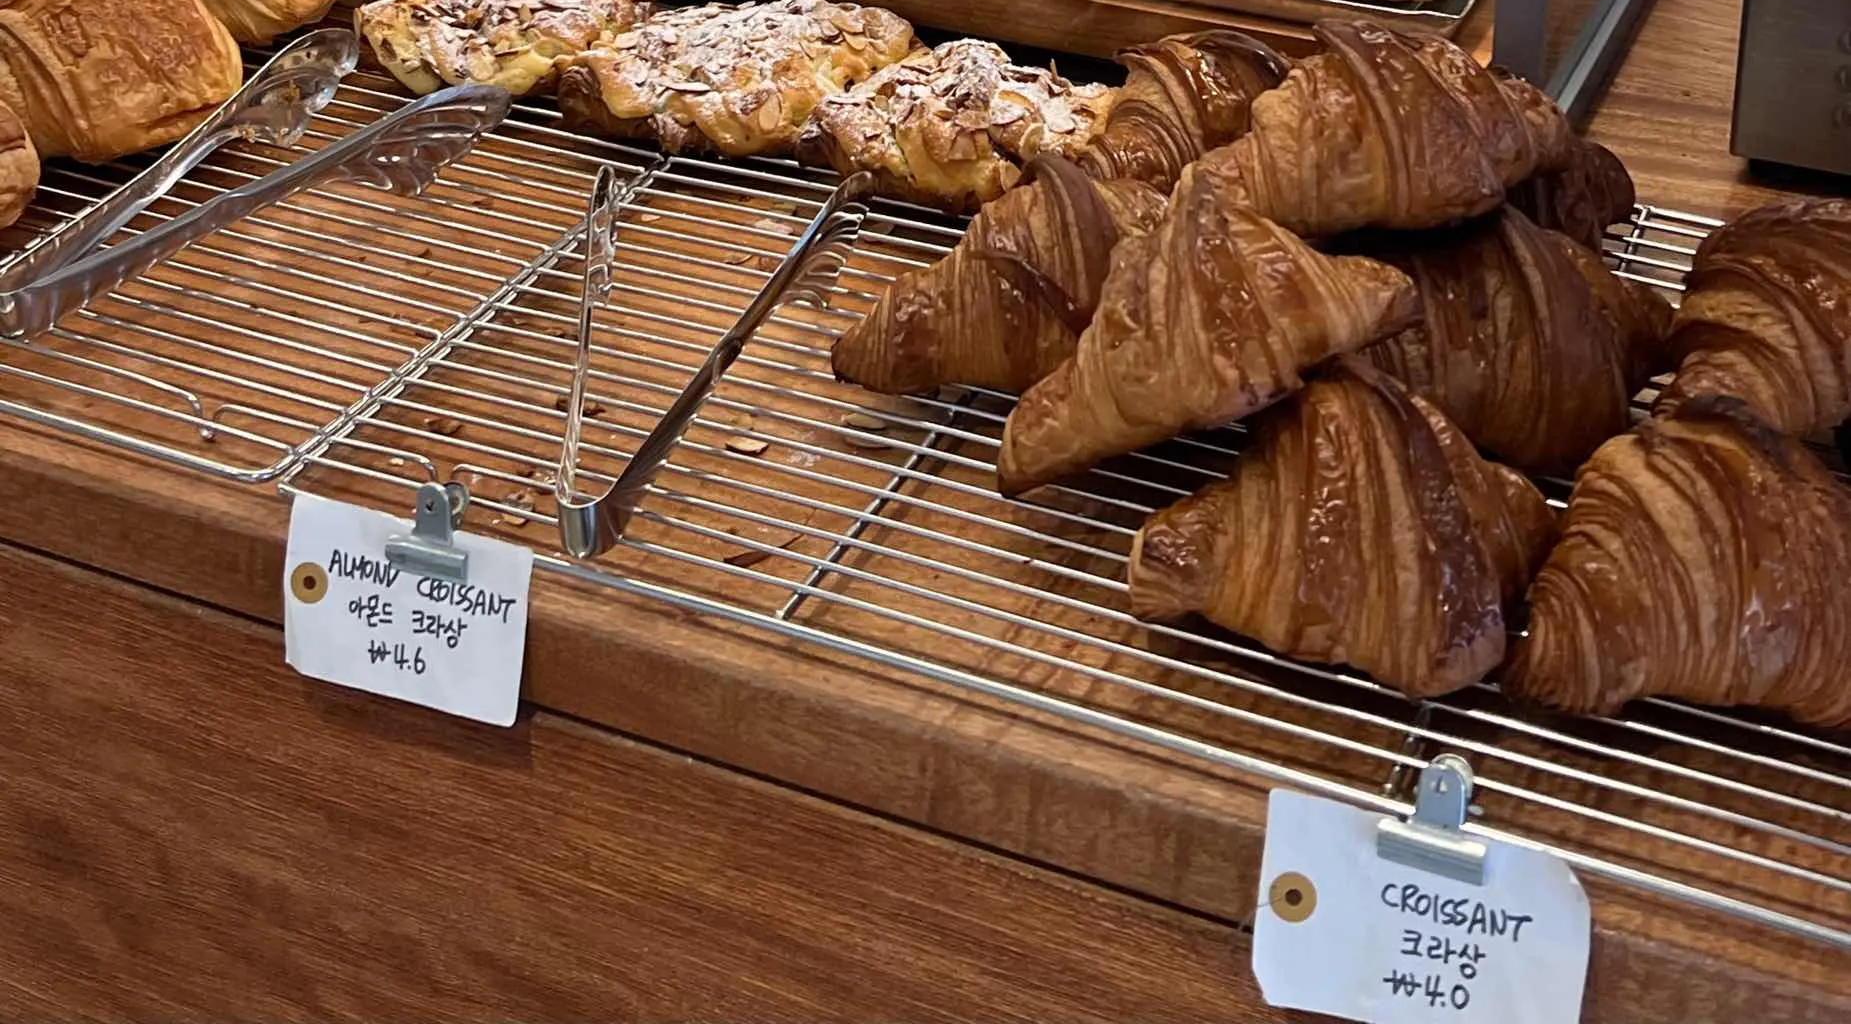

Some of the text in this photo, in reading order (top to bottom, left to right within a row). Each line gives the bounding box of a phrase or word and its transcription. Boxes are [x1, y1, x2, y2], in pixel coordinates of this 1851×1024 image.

[348, 594, 467, 649] 아몬드 크라상
[416, 576, 517, 624] CROISSANT
[1381, 883, 1534, 942] CROISSANT
[1400, 929, 1487, 980] 크라상
